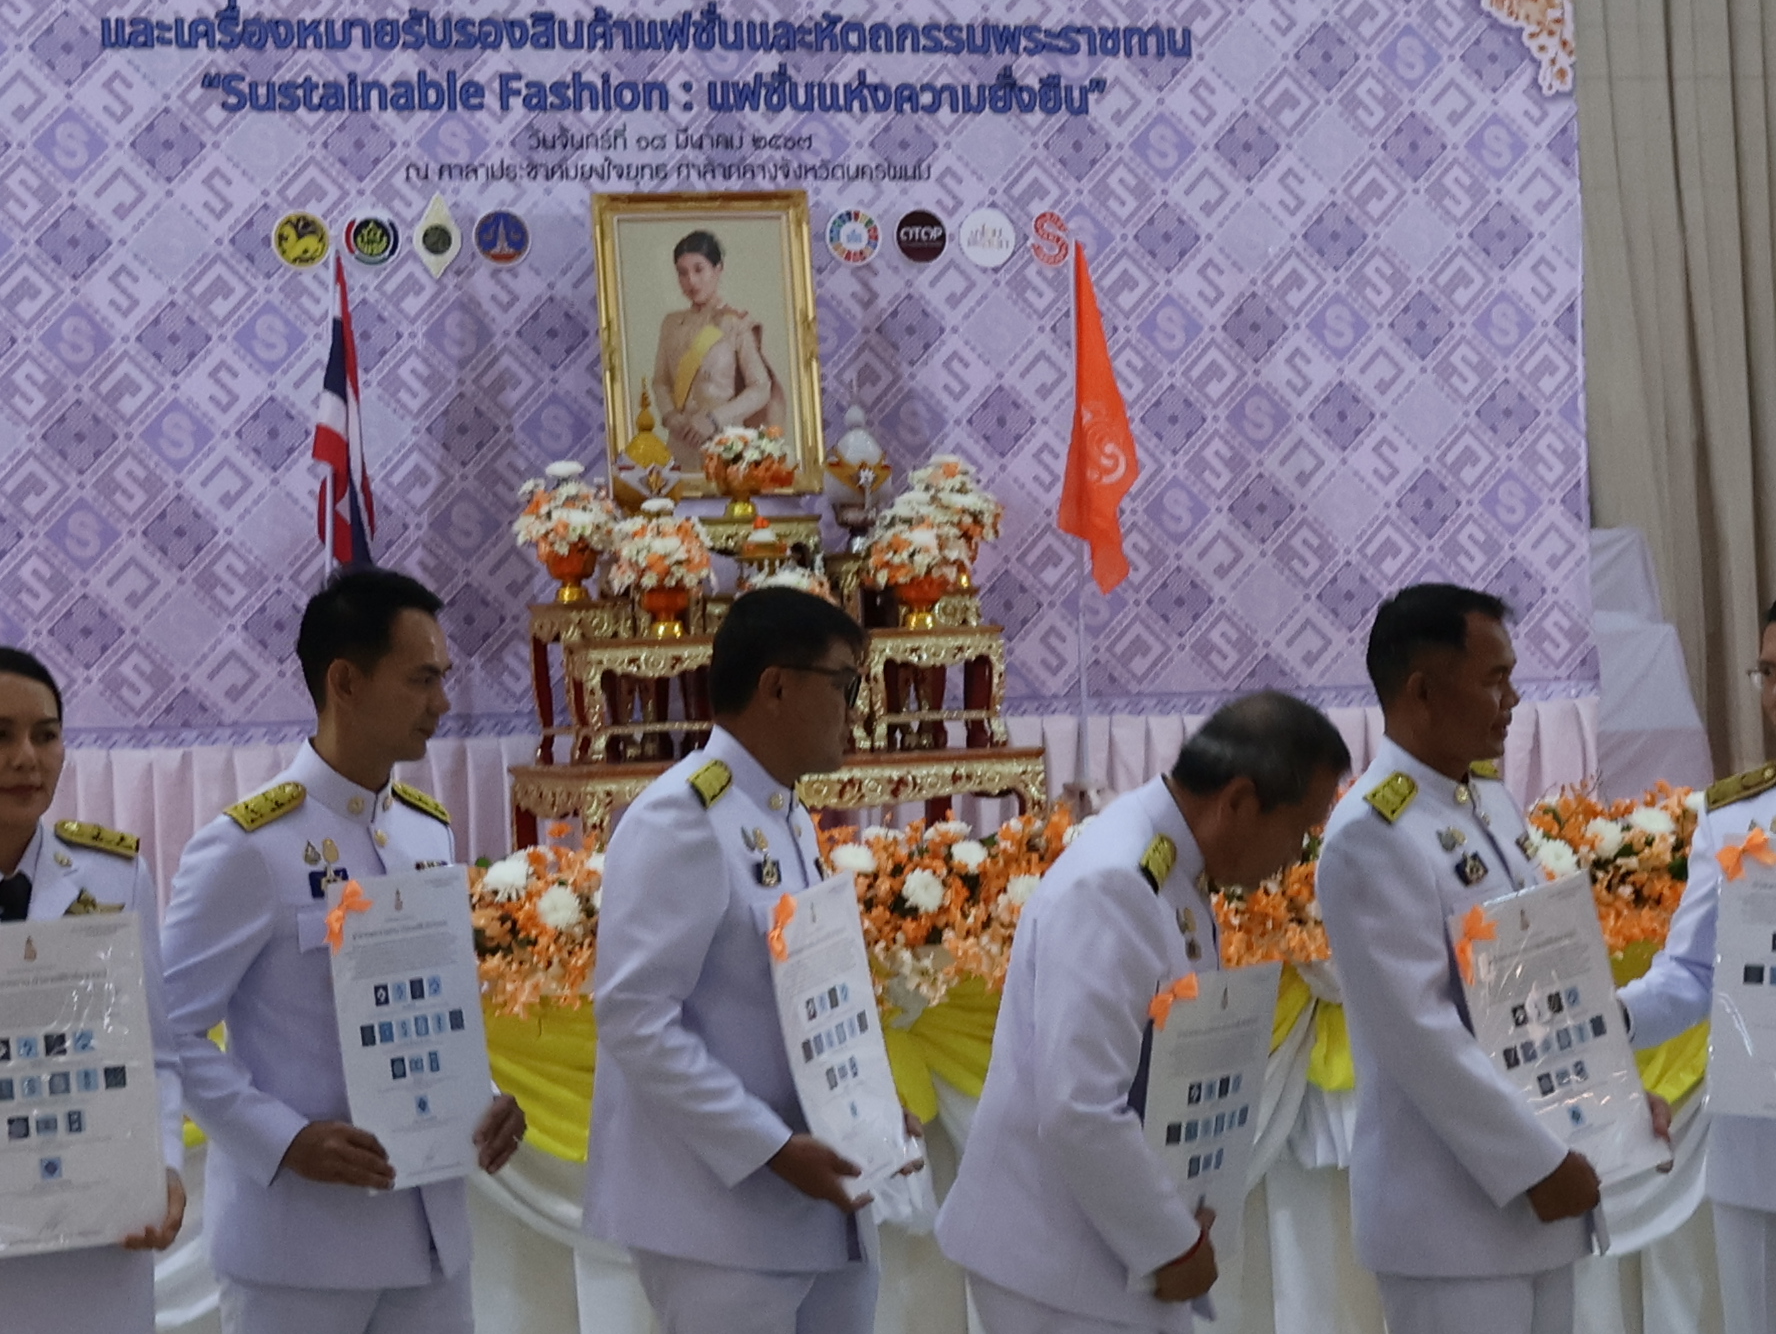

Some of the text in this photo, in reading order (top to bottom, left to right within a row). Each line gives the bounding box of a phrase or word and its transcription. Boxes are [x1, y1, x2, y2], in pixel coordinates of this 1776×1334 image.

[201, 70, 485, 112] “Sustainable
[499, 71, 669, 112] Fashion
[675, 128, 743, 151] มีนาคม
